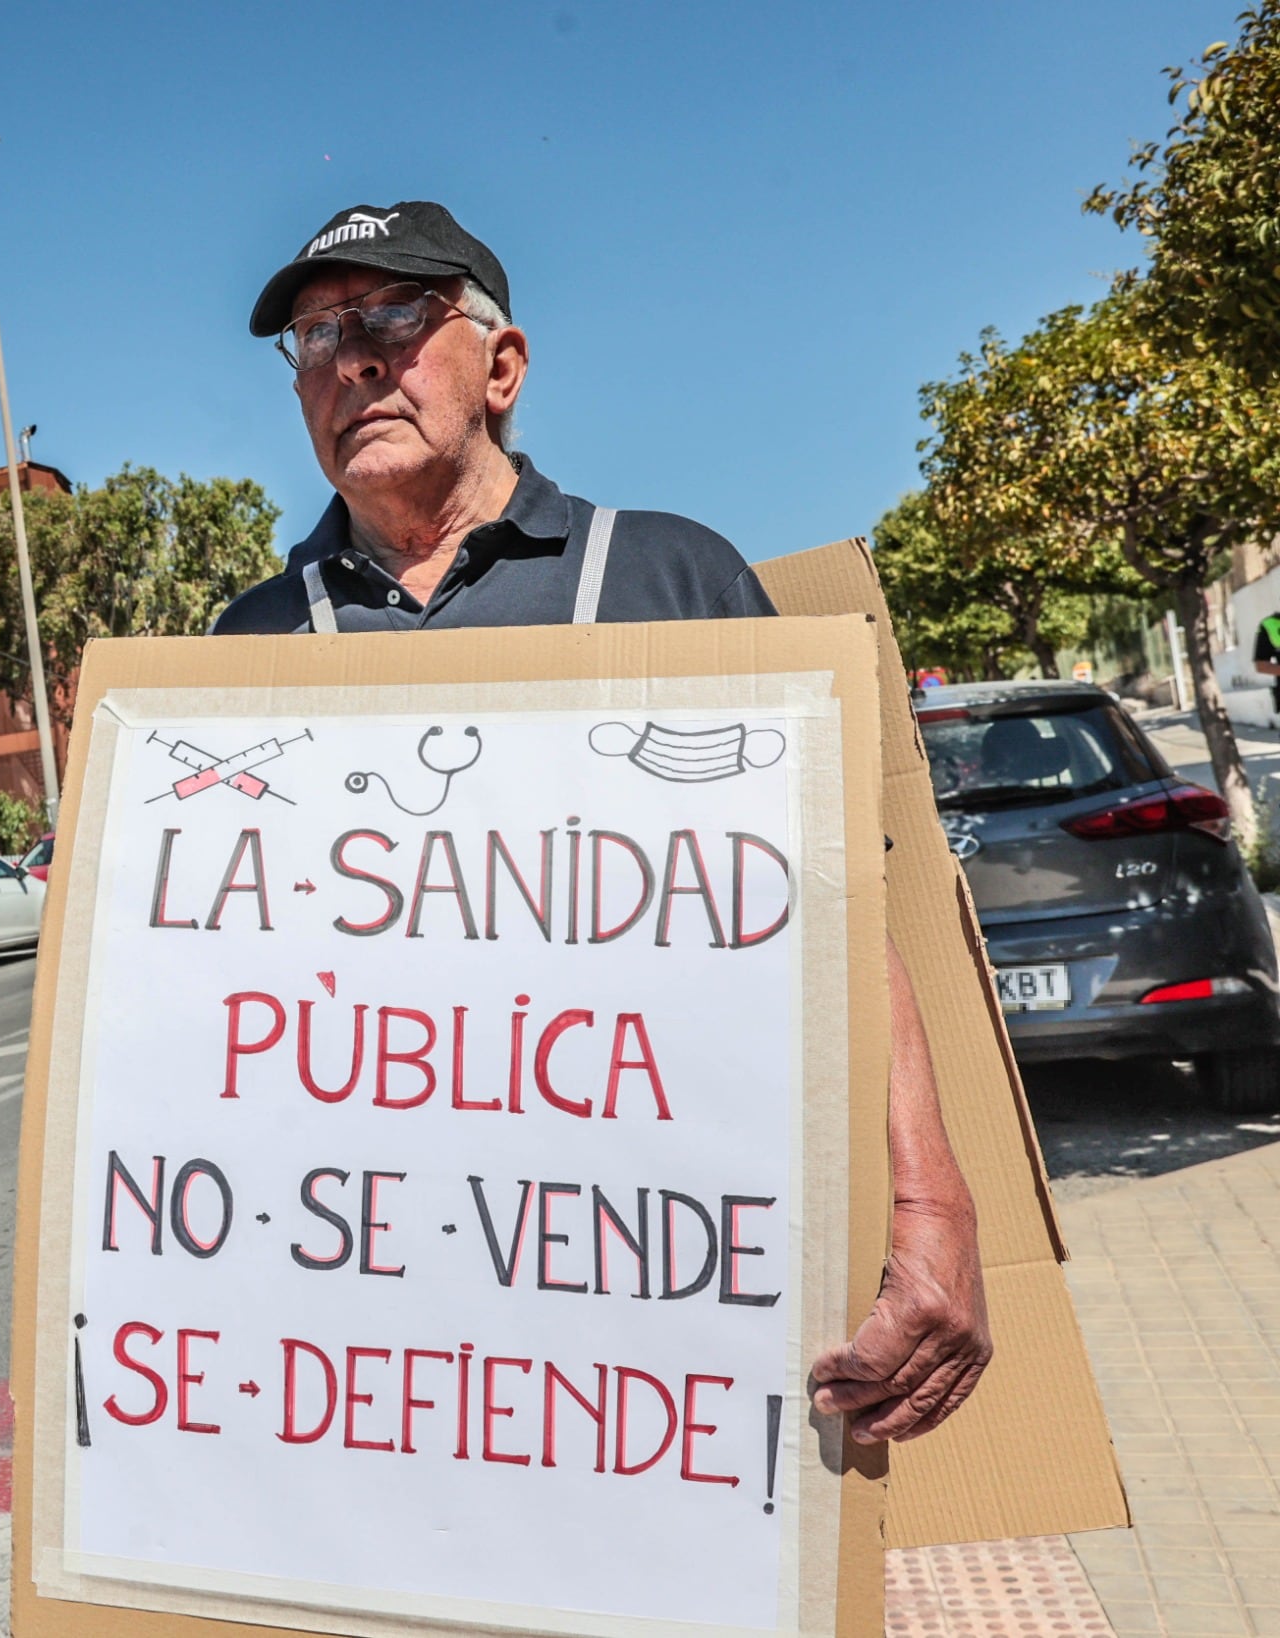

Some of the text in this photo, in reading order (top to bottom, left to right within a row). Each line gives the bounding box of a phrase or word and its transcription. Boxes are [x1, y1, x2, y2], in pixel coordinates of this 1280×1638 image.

[307, 222, 377, 257] PUMA
[149, 828, 274, 931] LA
[102, 1150, 782, 1307] NO SE VENDE
